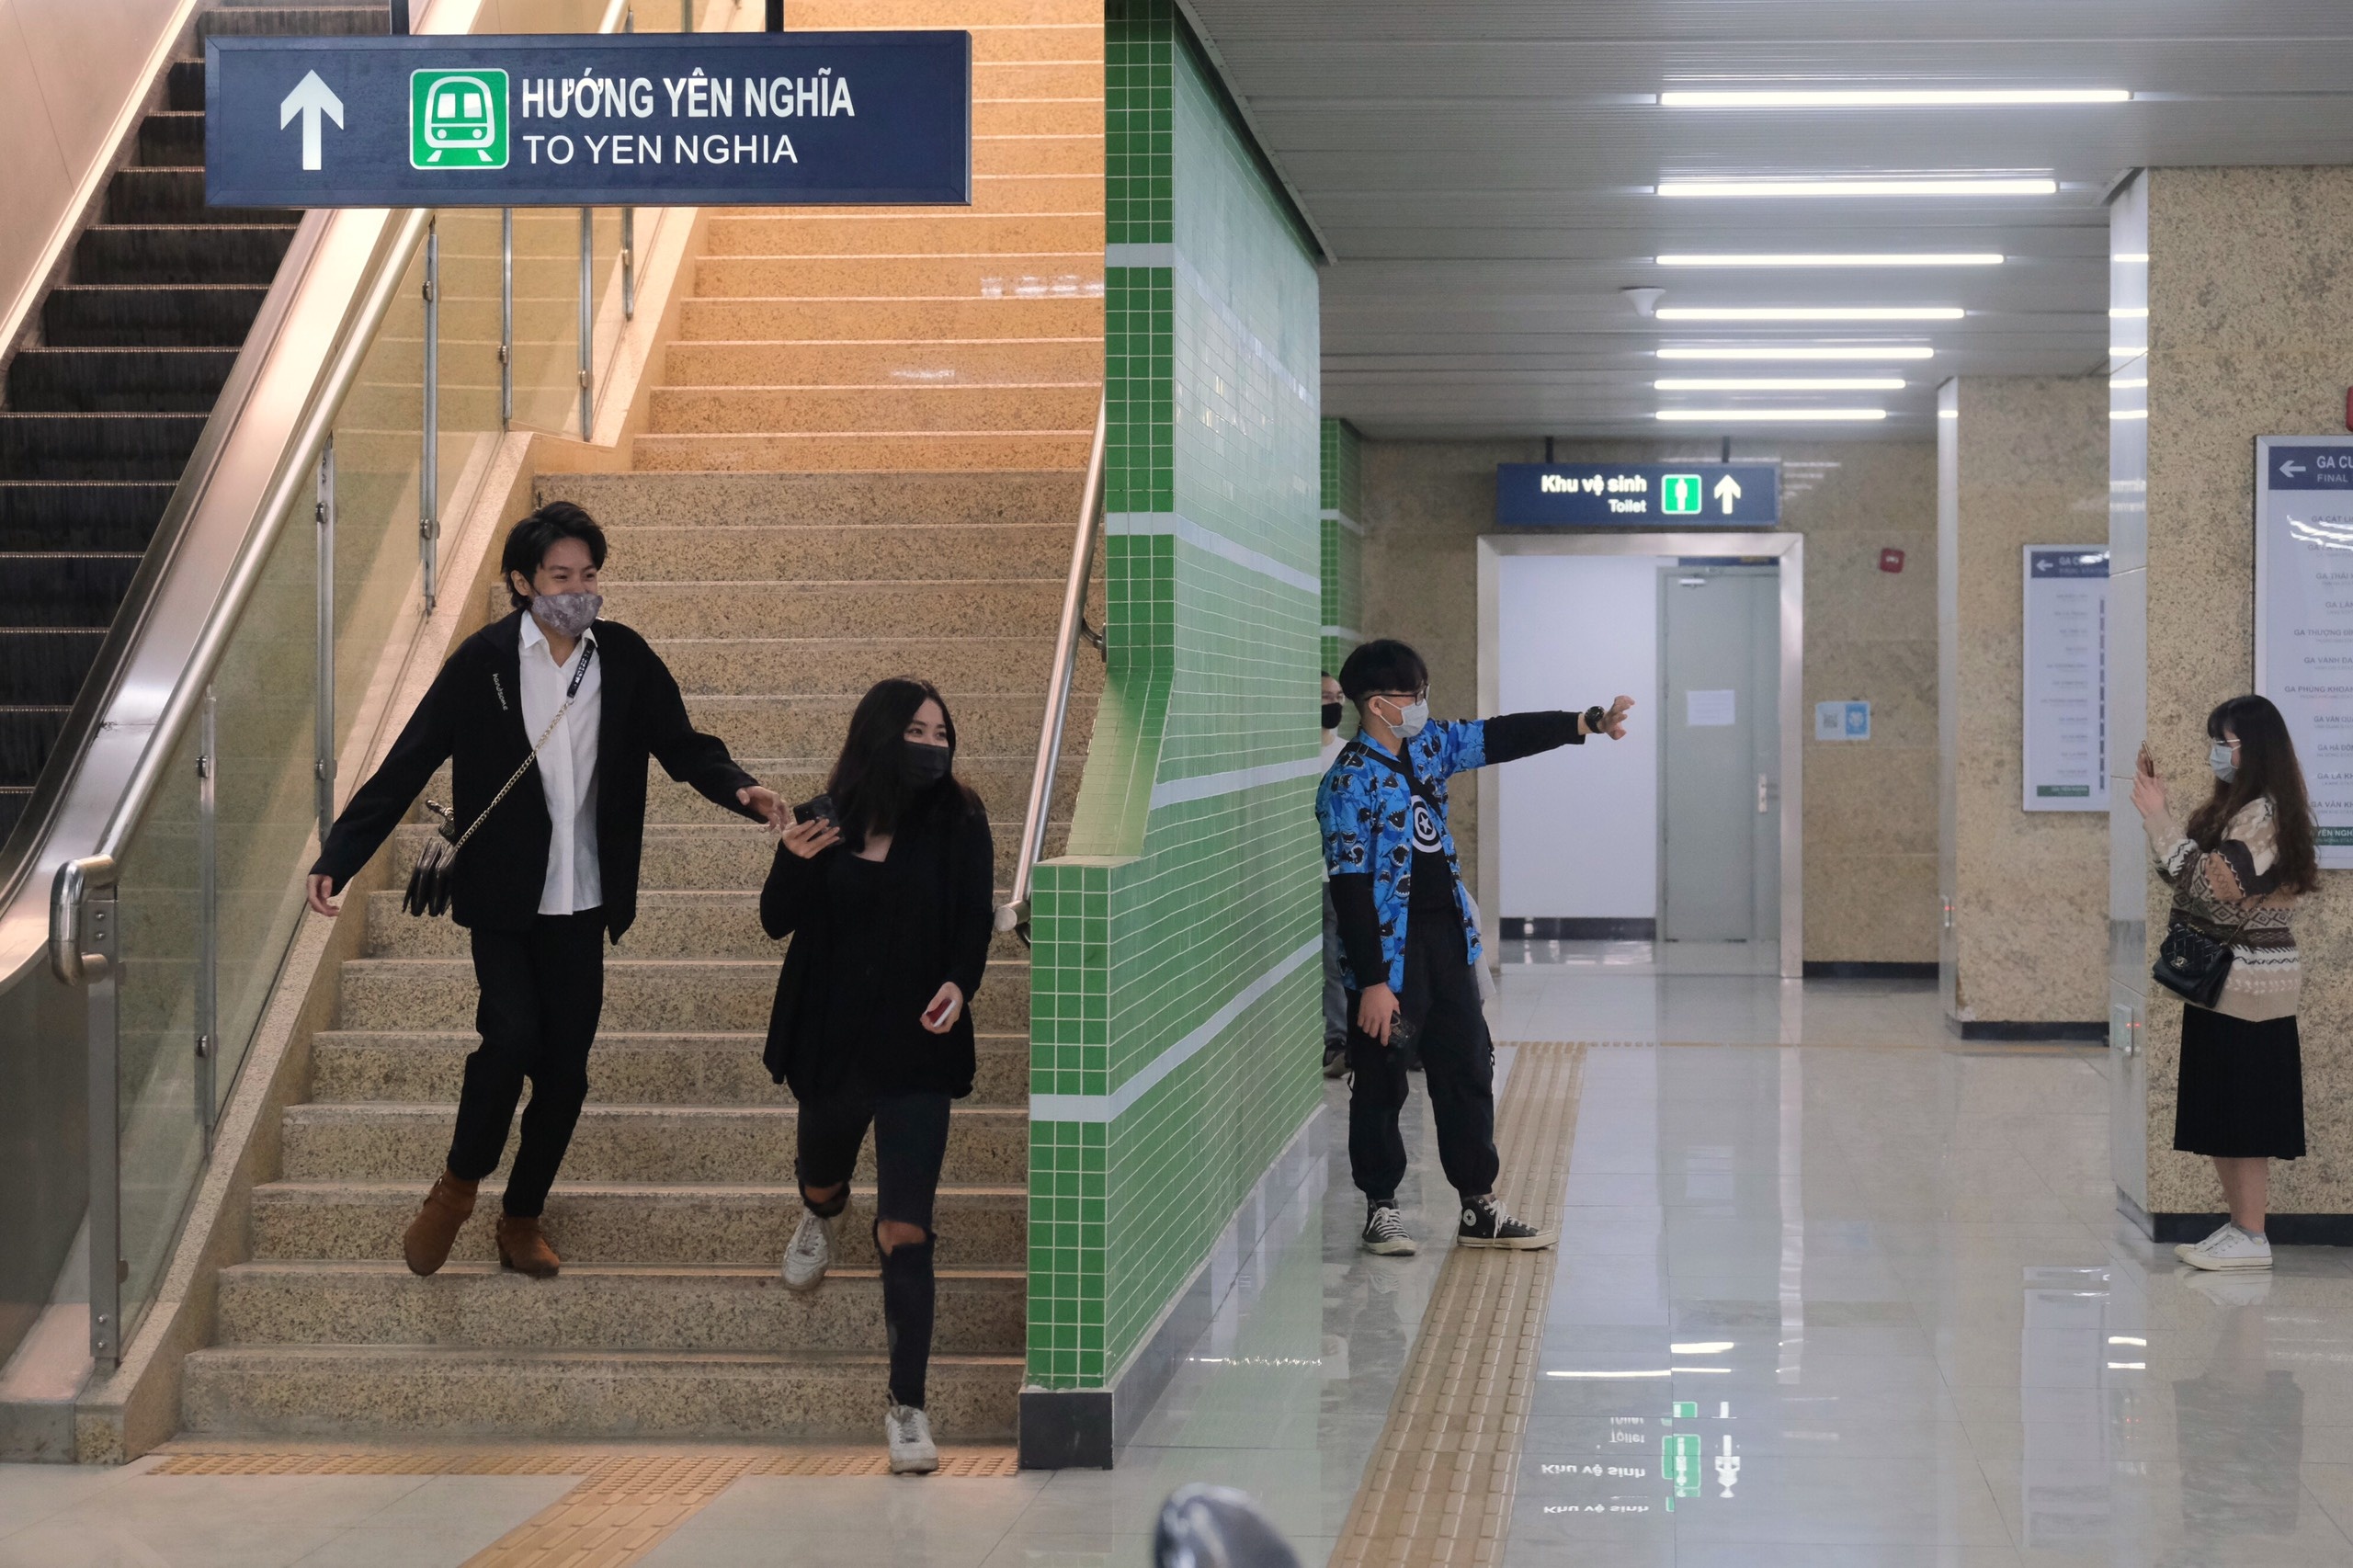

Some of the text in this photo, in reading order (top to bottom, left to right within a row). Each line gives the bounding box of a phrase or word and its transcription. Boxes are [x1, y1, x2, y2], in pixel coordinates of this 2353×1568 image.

[521, 67, 856, 119] HƯỚNG YÊN NGHĨA
[522, 134, 799, 165] TO YEN NGHIA
[2316, 455, 2336, 469] GA
[1540, 474, 1648, 496] Khu vệ sinh
[2317, 473, 2348, 483] FINAL
[1607, 498, 1647, 514] Toilet
[492, 673, 508, 711] handsome
